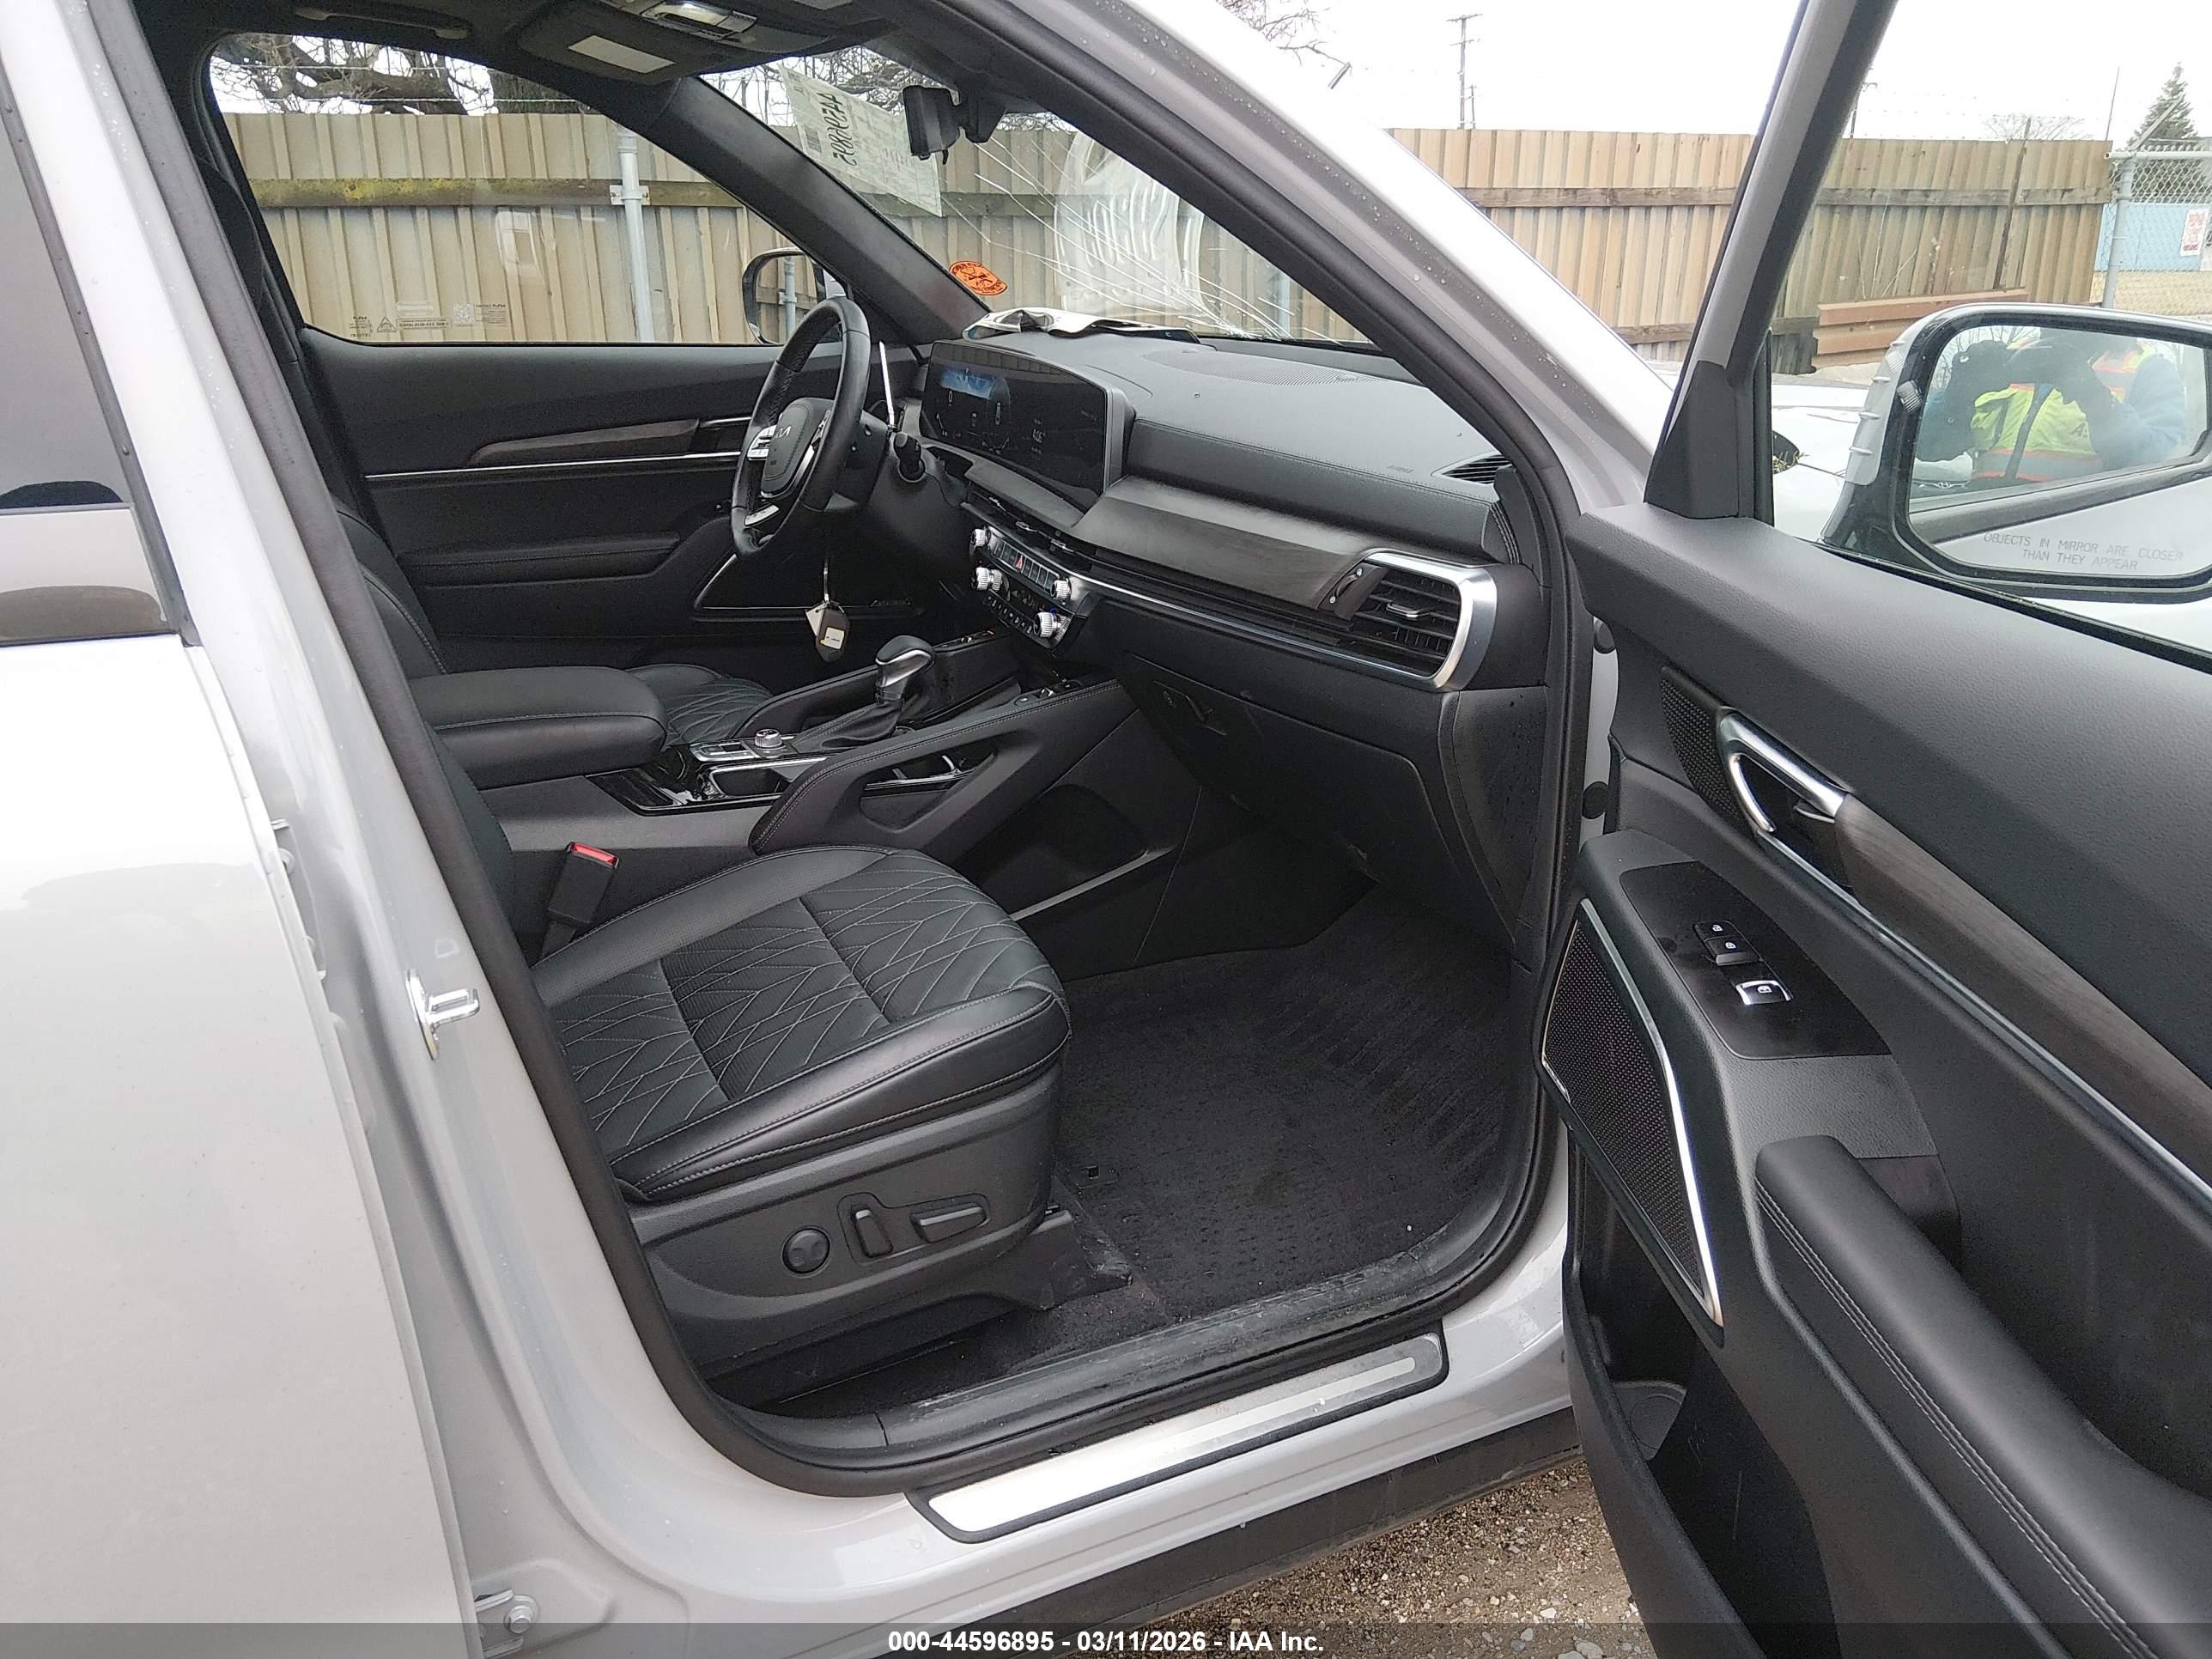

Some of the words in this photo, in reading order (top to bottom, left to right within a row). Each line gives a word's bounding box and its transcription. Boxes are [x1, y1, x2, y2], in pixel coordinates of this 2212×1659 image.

[1984, 532, 2032, 546] OBJECTS
[2039, 538, 2051, 548] IN
[2057, 540, 2099, 553] MIRROR
[2106, 544, 2130, 557] ARE
[2137, 547, 2184, 562] CLOSER
[2022, 550, 2051, 562] THAN
[2057, 552, 2086, 565] THEY
[2092, 556, 2138, 571] APPEAR
